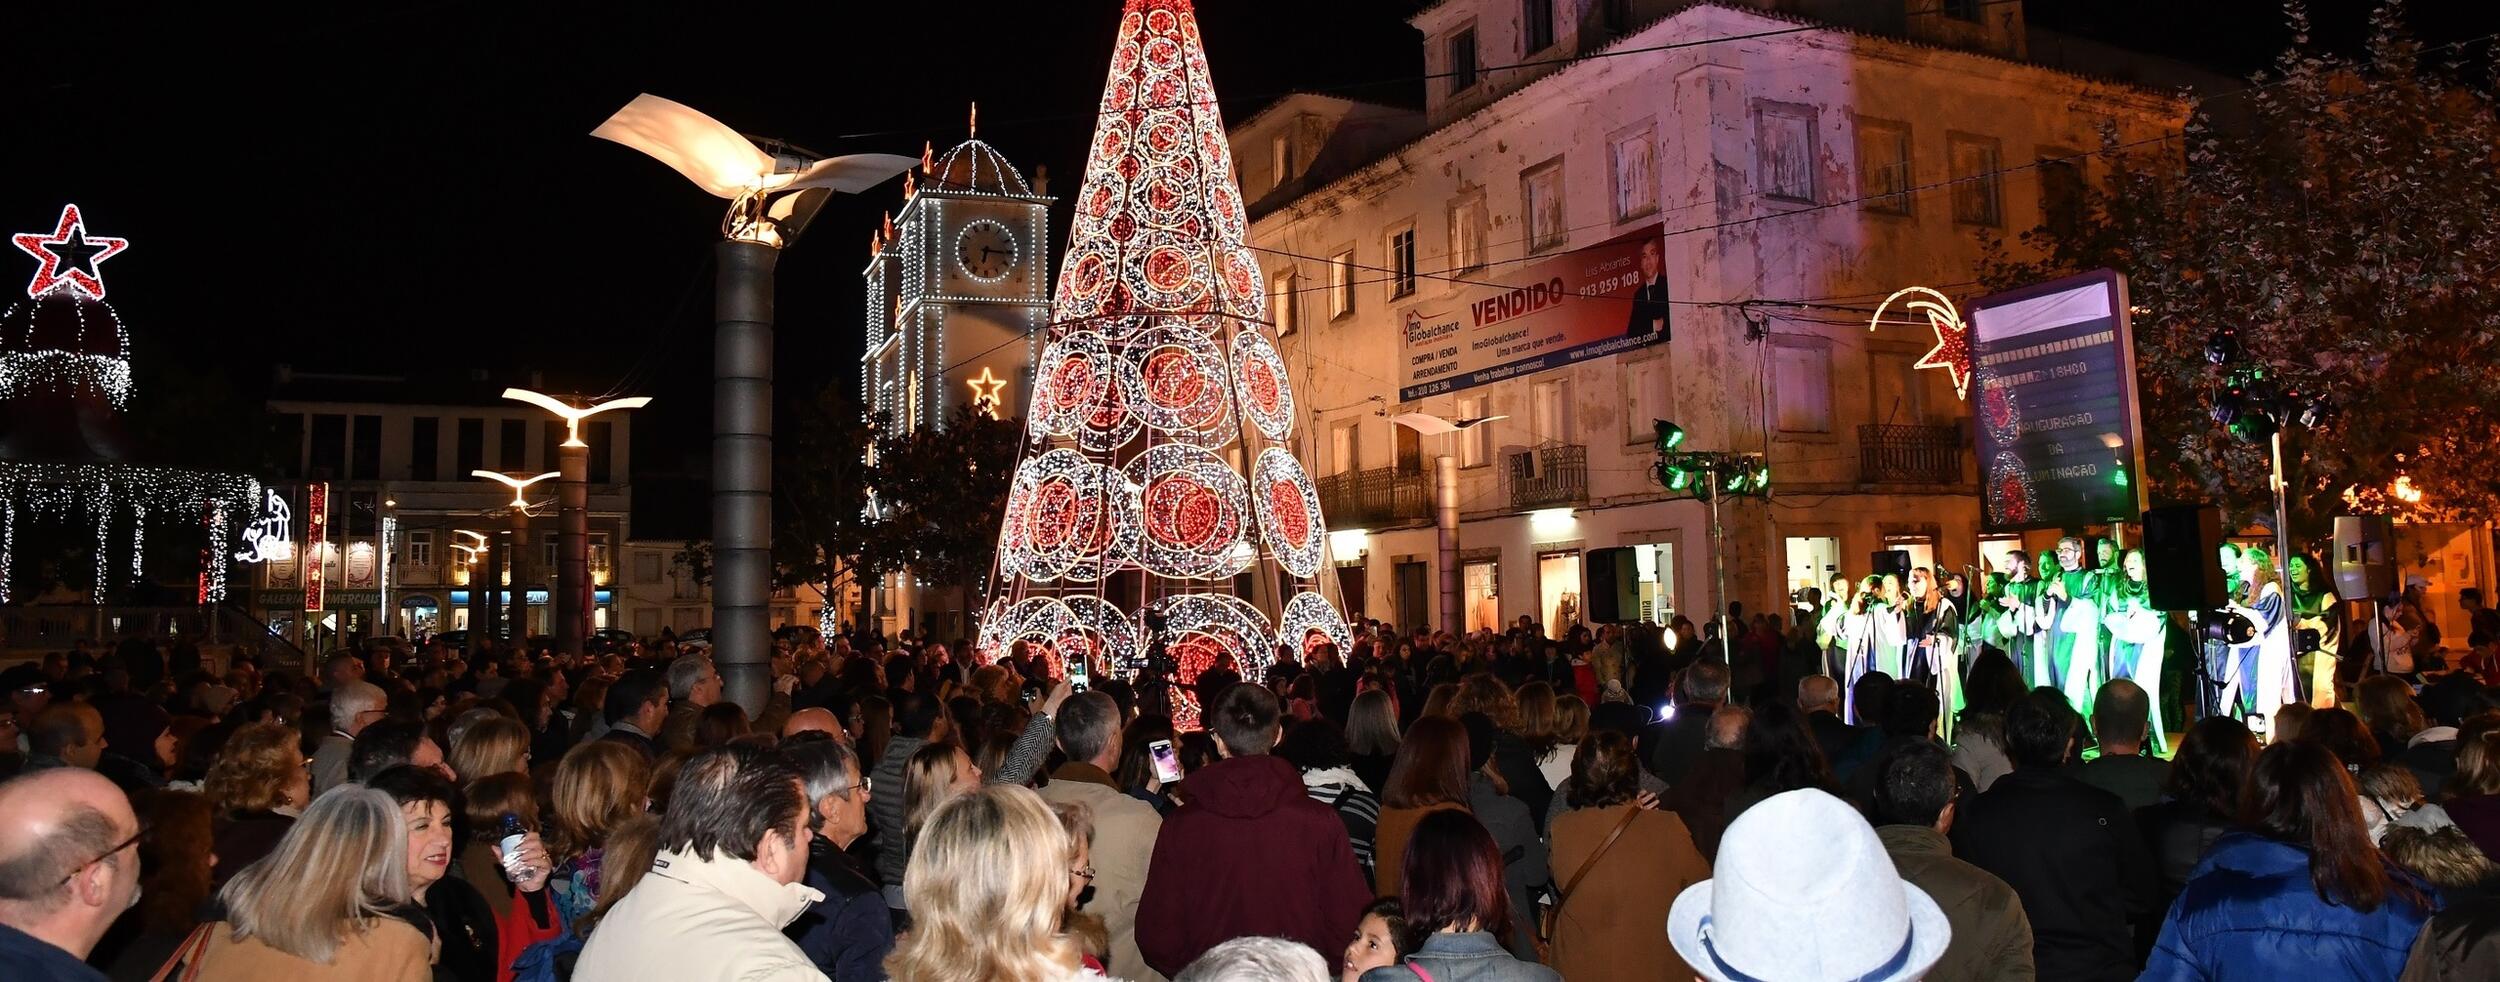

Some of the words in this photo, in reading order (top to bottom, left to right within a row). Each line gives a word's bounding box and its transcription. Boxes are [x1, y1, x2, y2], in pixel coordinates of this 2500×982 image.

[1579, 283, 1597, 300] 913
[1599, 276, 1618, 296] 259
[1621, 270, 1640, 288] 108
[1471, 277, 1564, 327] VENDIDO
[1408, 320, 1421, 333] Imo
[1408, 321, 1460, 343] Globalchance
[1472, 327, 1529, 352] ImoGlobalchance!
[1496, 344, 1511, 358] Uma
[1511, 340, 1531, 353] marca
[1532, 337, 1544, 351] que
[1545, 332, 1567, 346] vende.
[1569, 331, 1659, 360] www.imoglobalchance.com
[1411, 352, 1434, 366] COMPRA
[1438, 345, 1458, 360] VENDA
[1412, 360, 1458, 381] ARRENDAMENTO
[1473, 369, 1490, 384] Venha
[1489, 364, 1515, 381] trabalhar
[324, 592, 382, 606] OMERCIAIS
